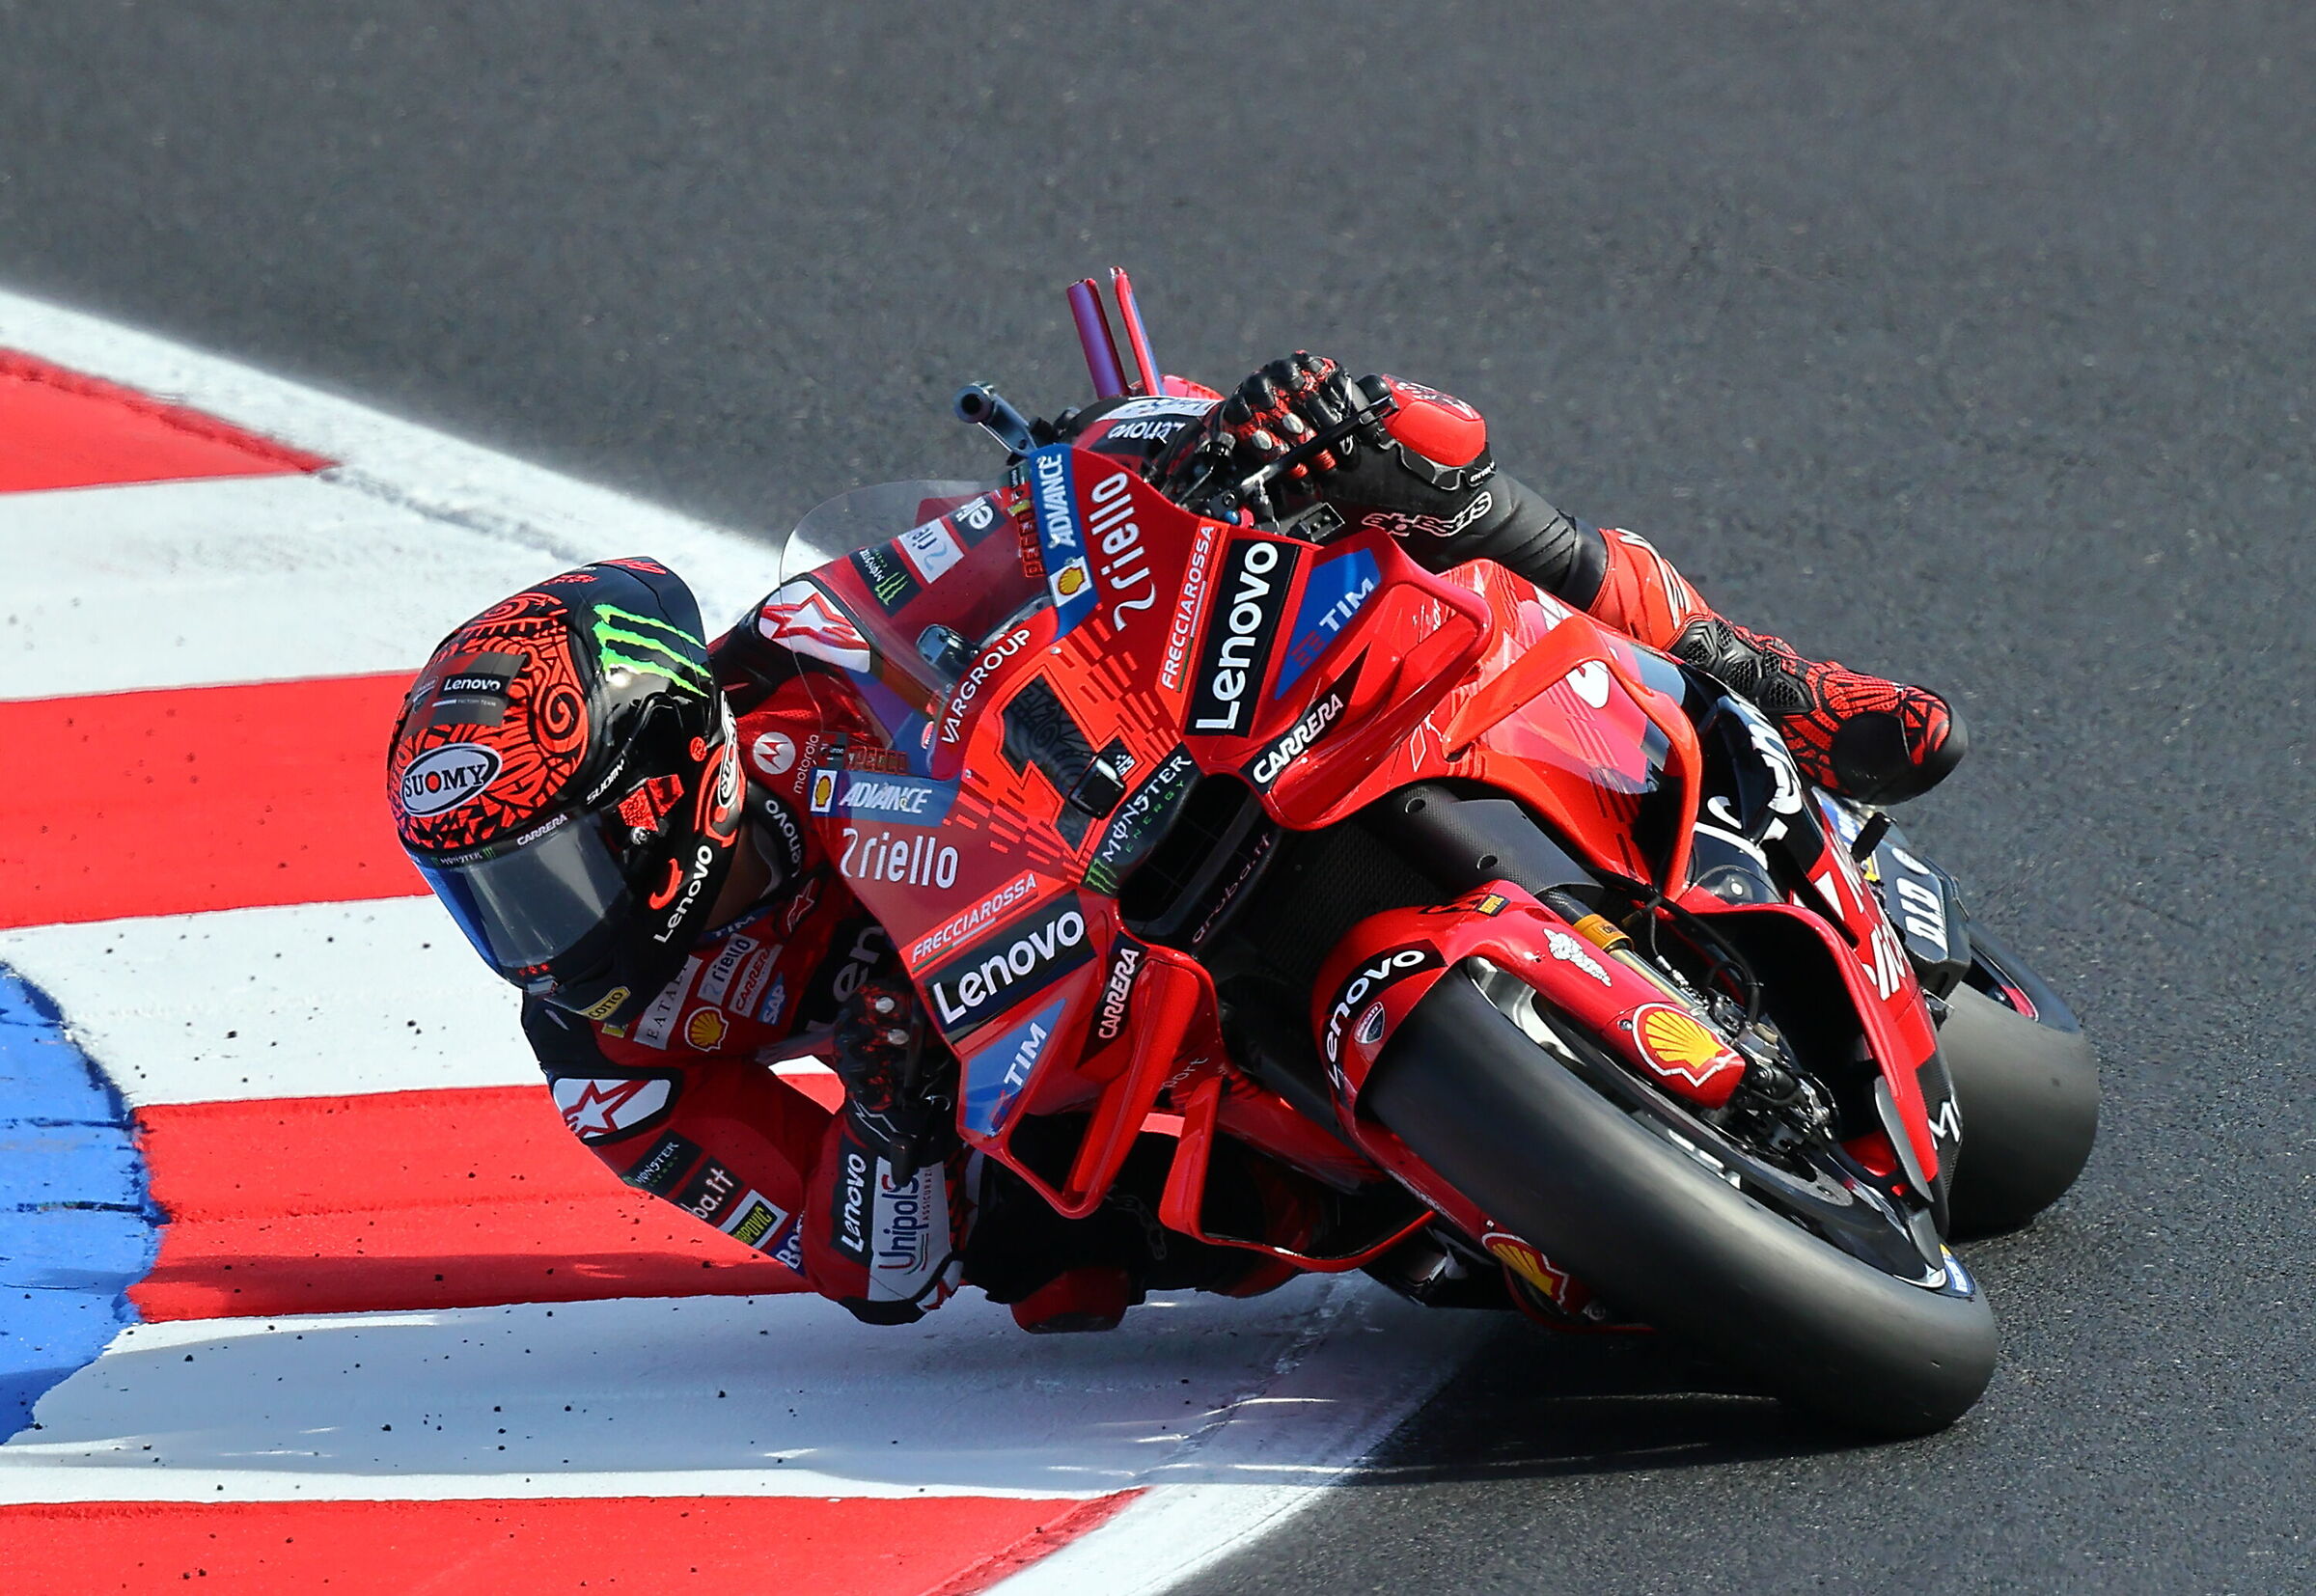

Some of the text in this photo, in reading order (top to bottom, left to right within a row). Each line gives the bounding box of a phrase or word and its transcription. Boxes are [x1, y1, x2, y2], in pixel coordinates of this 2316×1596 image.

[1040, 454, 1077, 549] ADVANCE
[1089, 472, 1150, 591] riello
[1161, 526, 1215, 690] FRECCIAROSSA
[1195, 542, 1279, 729] Lenovo
[1319, 578, 1374, 632] TIM
[443, 678, 501, 692] Lenovo
[941, 628, 1031, 744] VARGROUP
[793, 734, 819, 795] motorola
[1253, 693, 1344, 784] CARRERA
[403, 763, 486, 798] SUOMY
[587, 759, 625, 805] SUOMY
[839, 782, 932, 813] ADVANCE
[1102, 755, 1193, 863] MONSTER
[1125, 780, 1184, 853] ENERGY
[516, 813, 567, 846] CARRERA
[858, 831, 959, 889] riello
[653, 845, 713, 944] Lenovo
[911, 872, 1036, 963] FRECCIAROSSA
[713, 938, 751, 982] riello
[933, 911, 1085, 1025] Lenovo
[1098, 948, 1139, 1039] CARRERA
[648, 965, 688, 1040] EATAL
[762, 984, 786, 1025] SAP
[1326, 950, 1425, 1089] Lenovo
[1004, 1022, 1048, 1087] TIM
[635, 1142, 679, 1185] MONSTER
[841, 1153, 867, 1253] Lenovo
